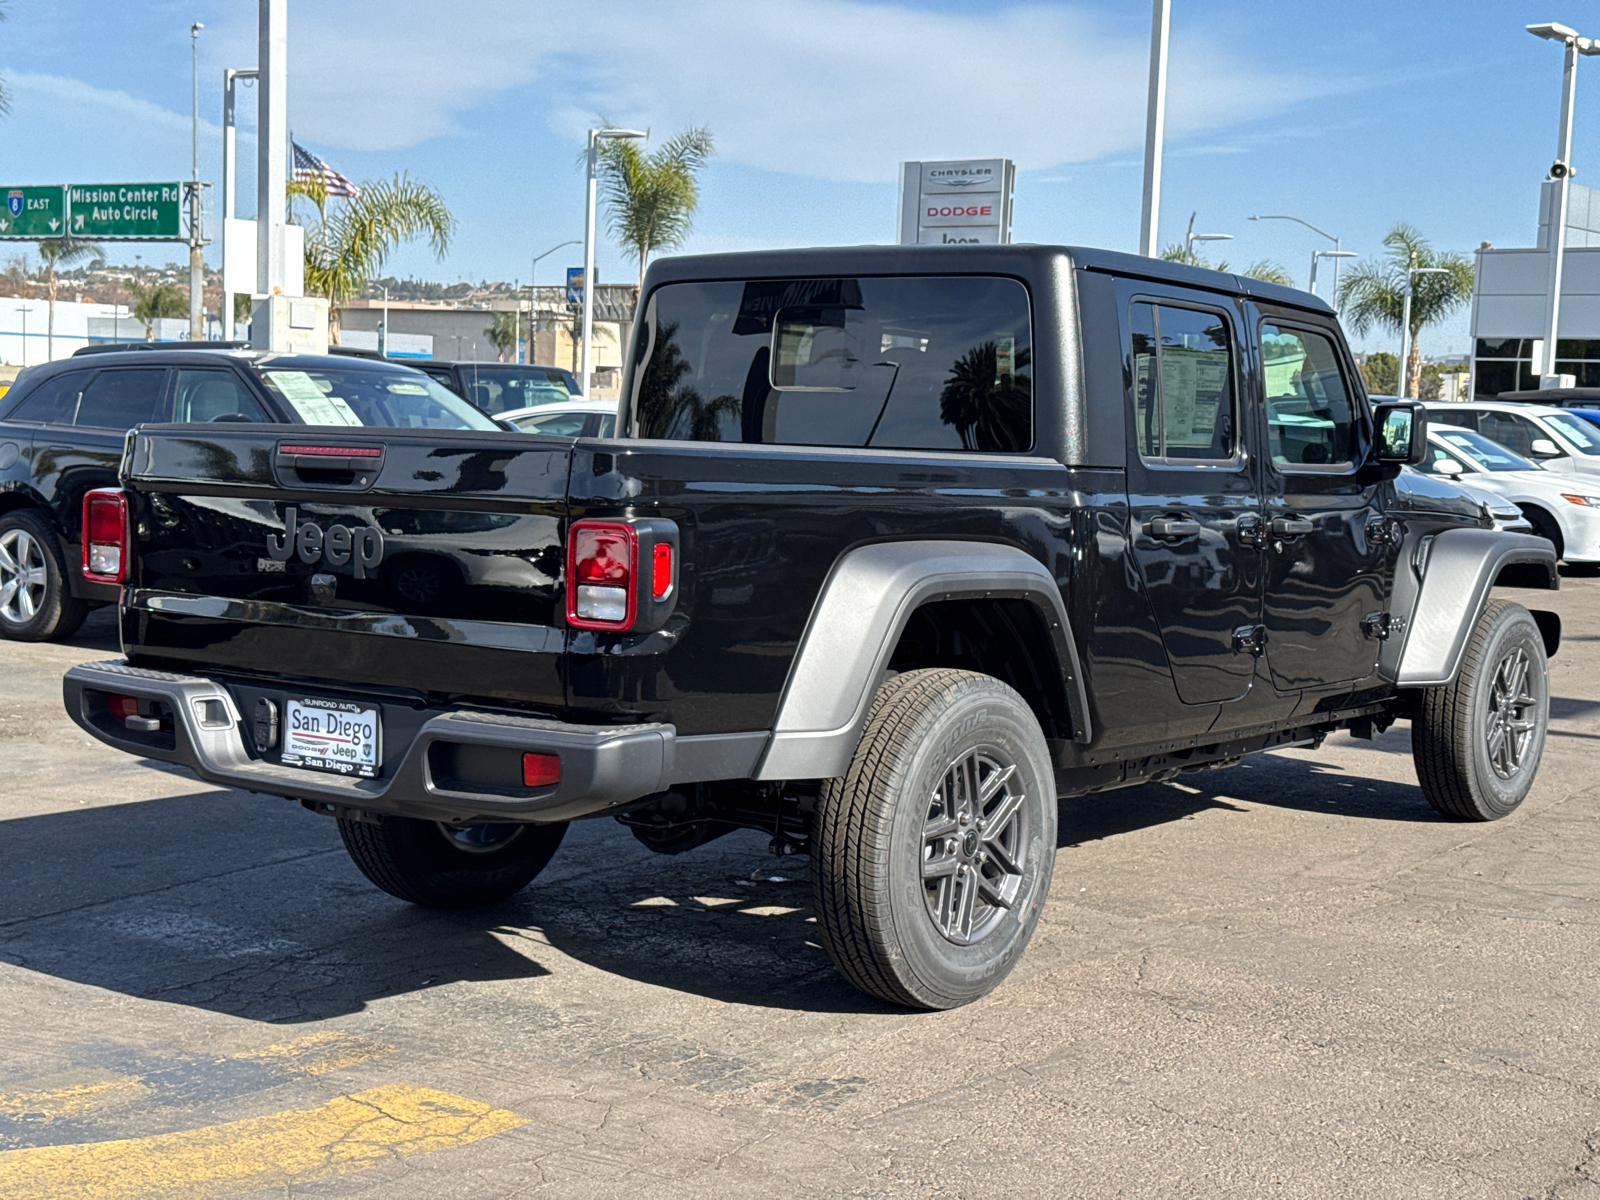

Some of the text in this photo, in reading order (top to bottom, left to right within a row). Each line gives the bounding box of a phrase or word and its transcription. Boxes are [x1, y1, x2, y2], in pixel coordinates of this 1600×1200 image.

[930, 168, 992, 177] CHRYSLER
[72, 187, 178, 203] Mission Center Rd
[12, 198, 50, 212] 8 EAST
[92, 205, 159, 221] Auto Circle
[927, 206, 992, 217] DODGE
[266, 506, 384, 580] Jeep
[304, 698, 337, 708] SUNROAD
[292, 709, 372, 745] San Diego
[332, 743, 357, 760] Jeep
[305, 757, 323, 767] San
[325, 759, 353, 773] Diego
